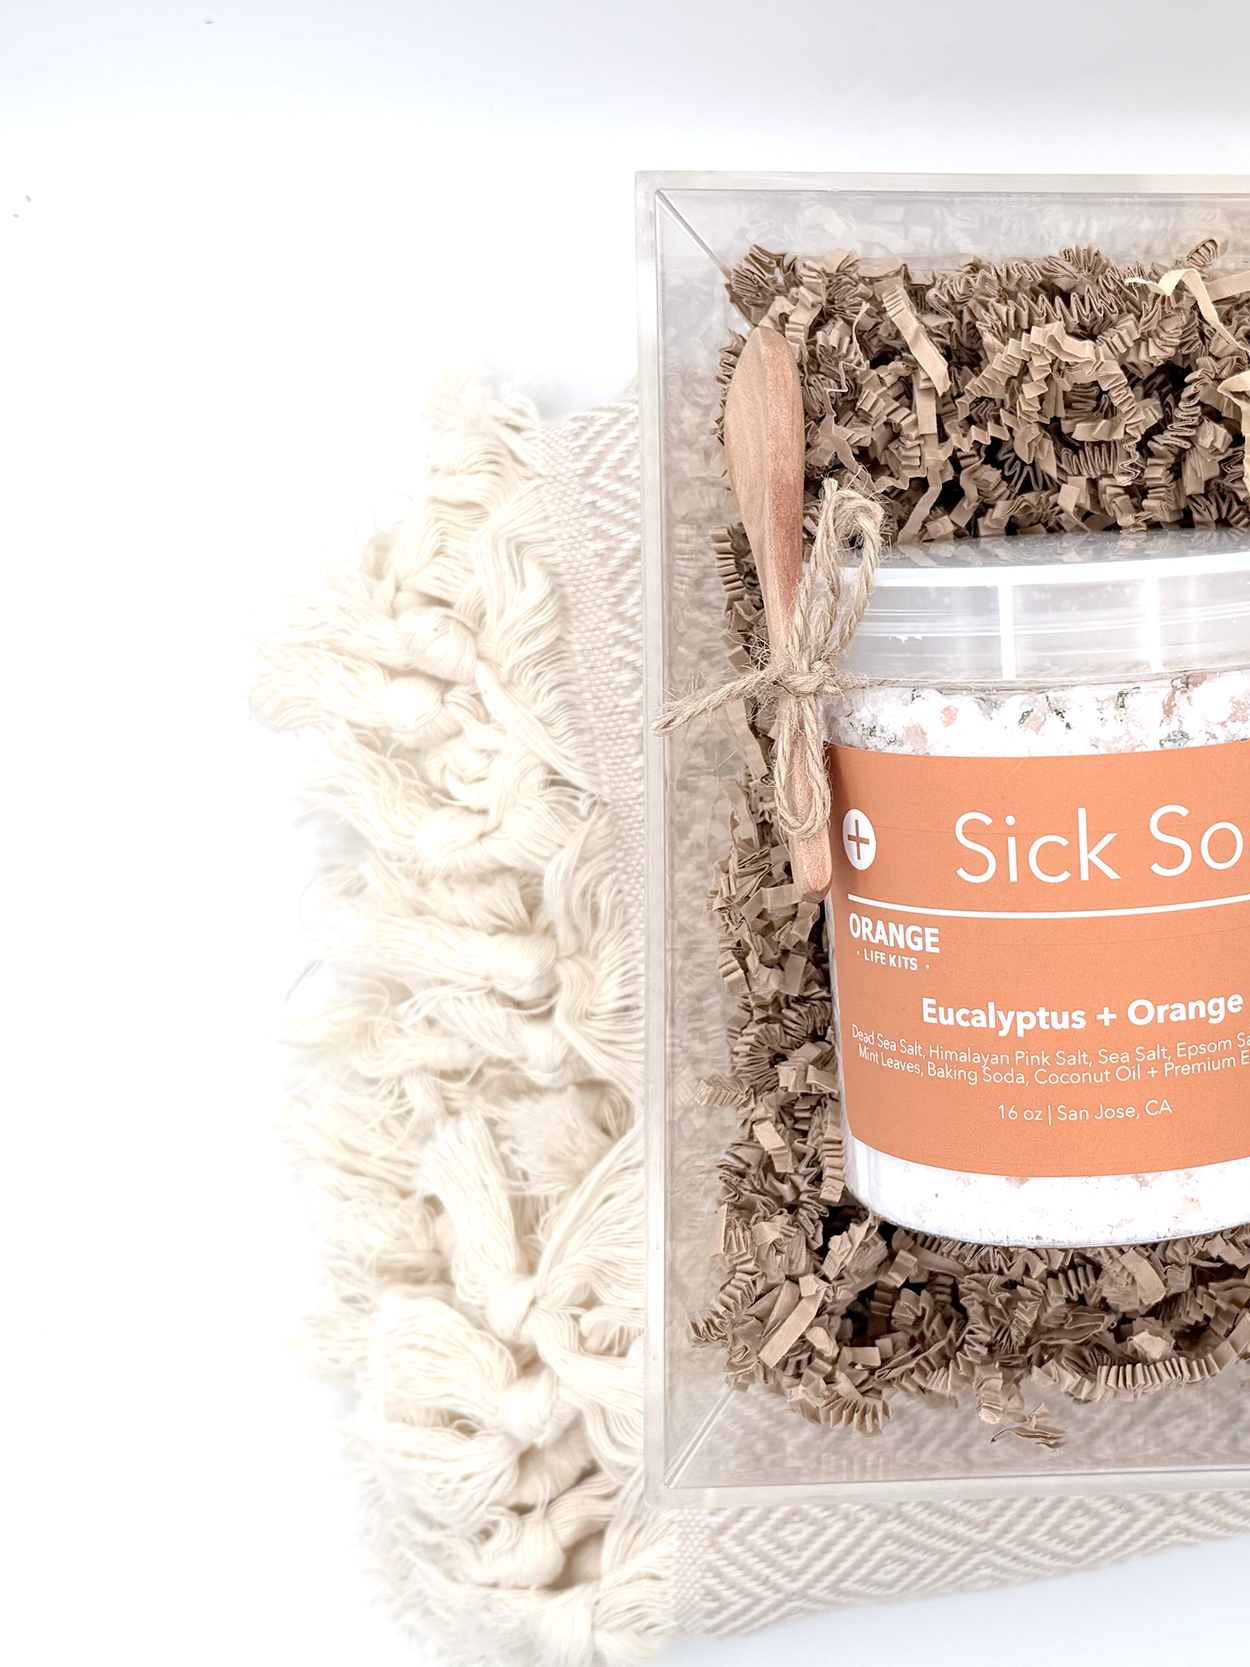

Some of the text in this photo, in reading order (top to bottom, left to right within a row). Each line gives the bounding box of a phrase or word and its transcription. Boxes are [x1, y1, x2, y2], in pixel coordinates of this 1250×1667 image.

[954, 807, 1121, 884] Sick
[849, 912, 940, 953] ORANGE
[863, 948, 918, 970] LIFE KITS
[921, 993, 1243, 1037] Eucalyptus + Orange
[851, 1024, 875, 1045] Dead
[877, 1033, 897, 1051] Sea
[899, 1038, 926, 1059] Salt,
[929, 1044, 1010, 1068] Himalayan
[1015, 1049, 1051, 1066] Pink
[1055, 1048, 1093, 1067] Salt,
[1098, 1049, 1130, 1065] Sea
[1135, 1044, 1171, 1062] Salt,
[1176, 1038, 1232, 1060] Epsom
[858, 1043, 880, 1065] Mint
[881, 1051, 924, 1077] Leaves,
[927, 1061, 978, 1085] Baking
[982, 1066, 1030, 1086] Soda,
[1034, 1068, 1110, 1085] Coconut
[1115, 1064, 1141, 1081] Oil
[1146, 1066, 1158, 1078] +
[1164, 1054, 1236, 1077] Premium
[998, 1104, 1018, 1120] 16
[1023, 1107, 1043, 1121] oz
[1057, 1104, 1089, 1120] San
[1094, 1104, 1140, 1120] Jose,
[1145, 1099, 1173, 1116] CA
